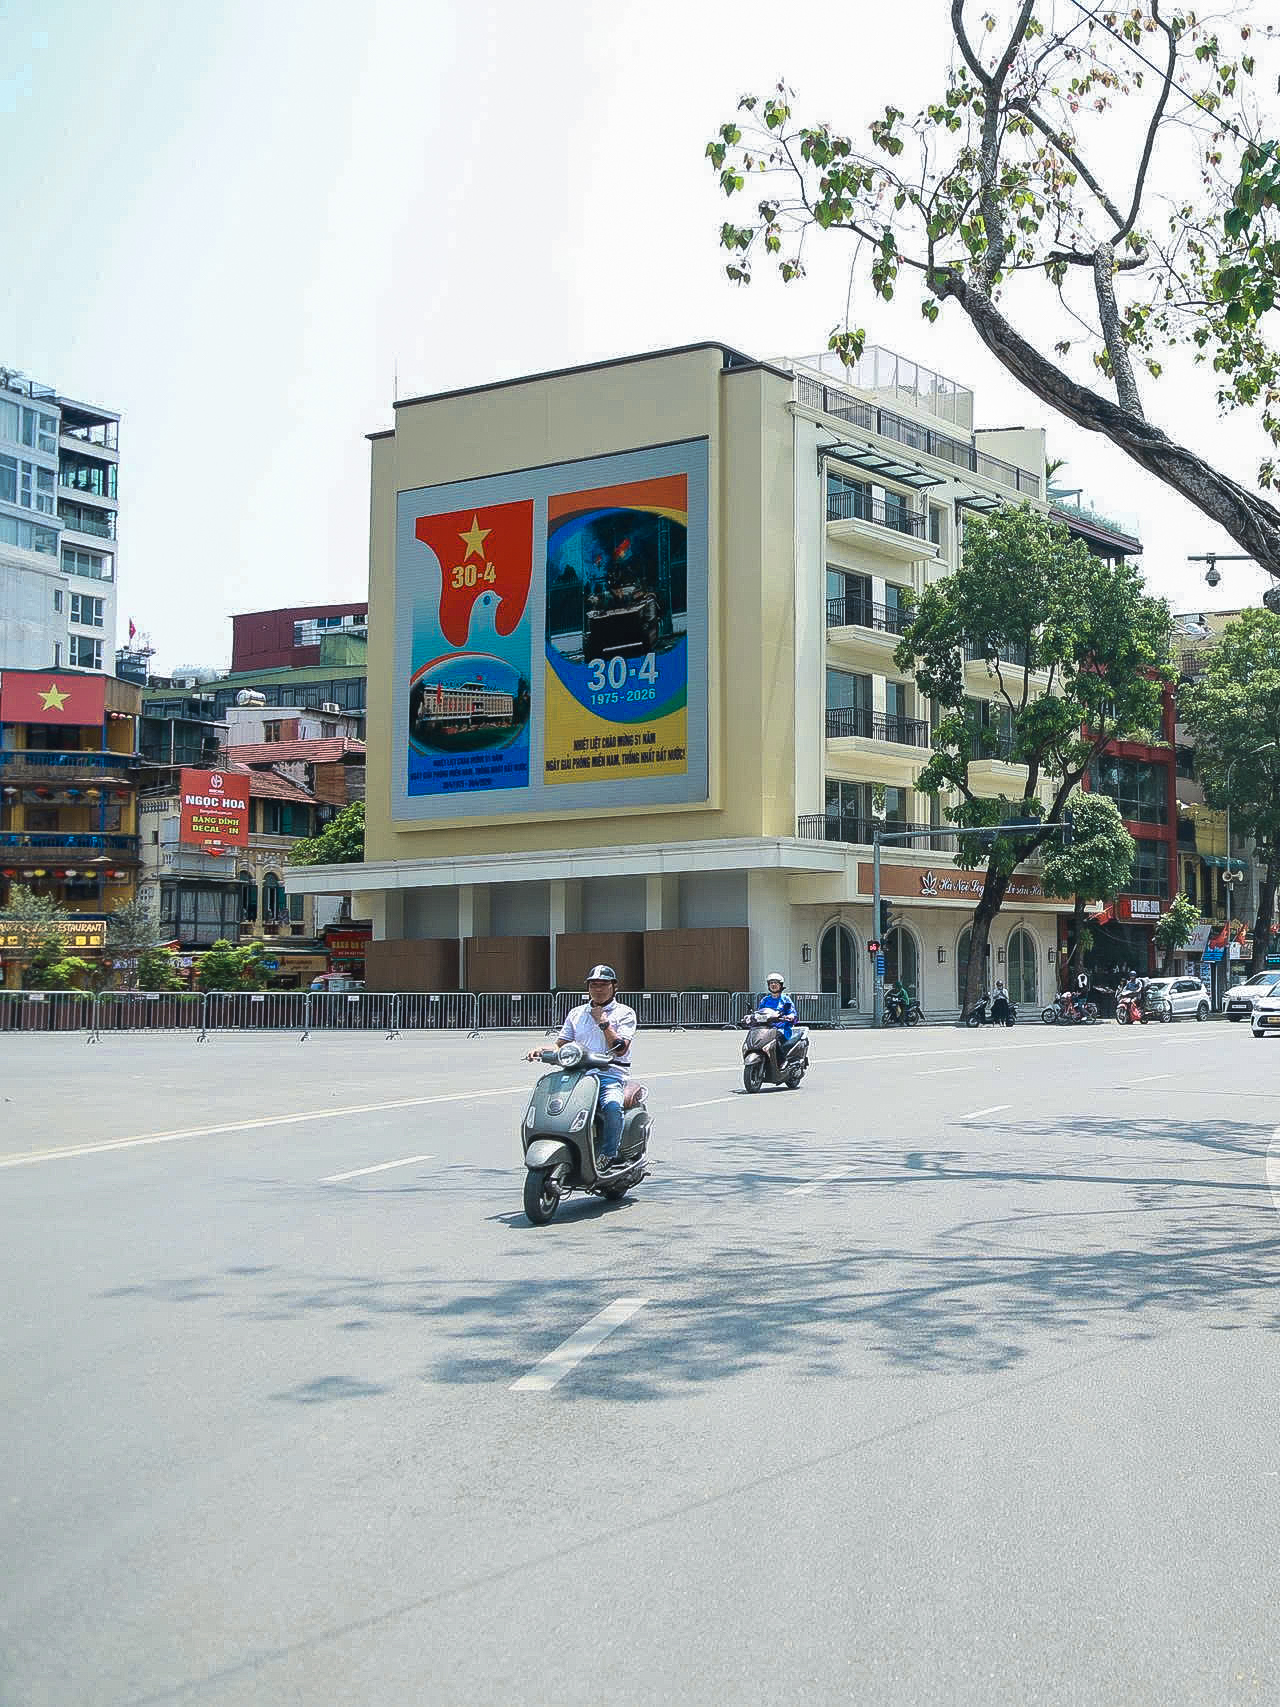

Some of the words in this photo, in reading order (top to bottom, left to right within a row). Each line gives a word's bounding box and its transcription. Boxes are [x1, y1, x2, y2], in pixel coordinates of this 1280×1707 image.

[185, 794, 219, 808] NGỌC
[222, 798, 246, 809] HOA
[192, 824, 220, 832] DECAL
